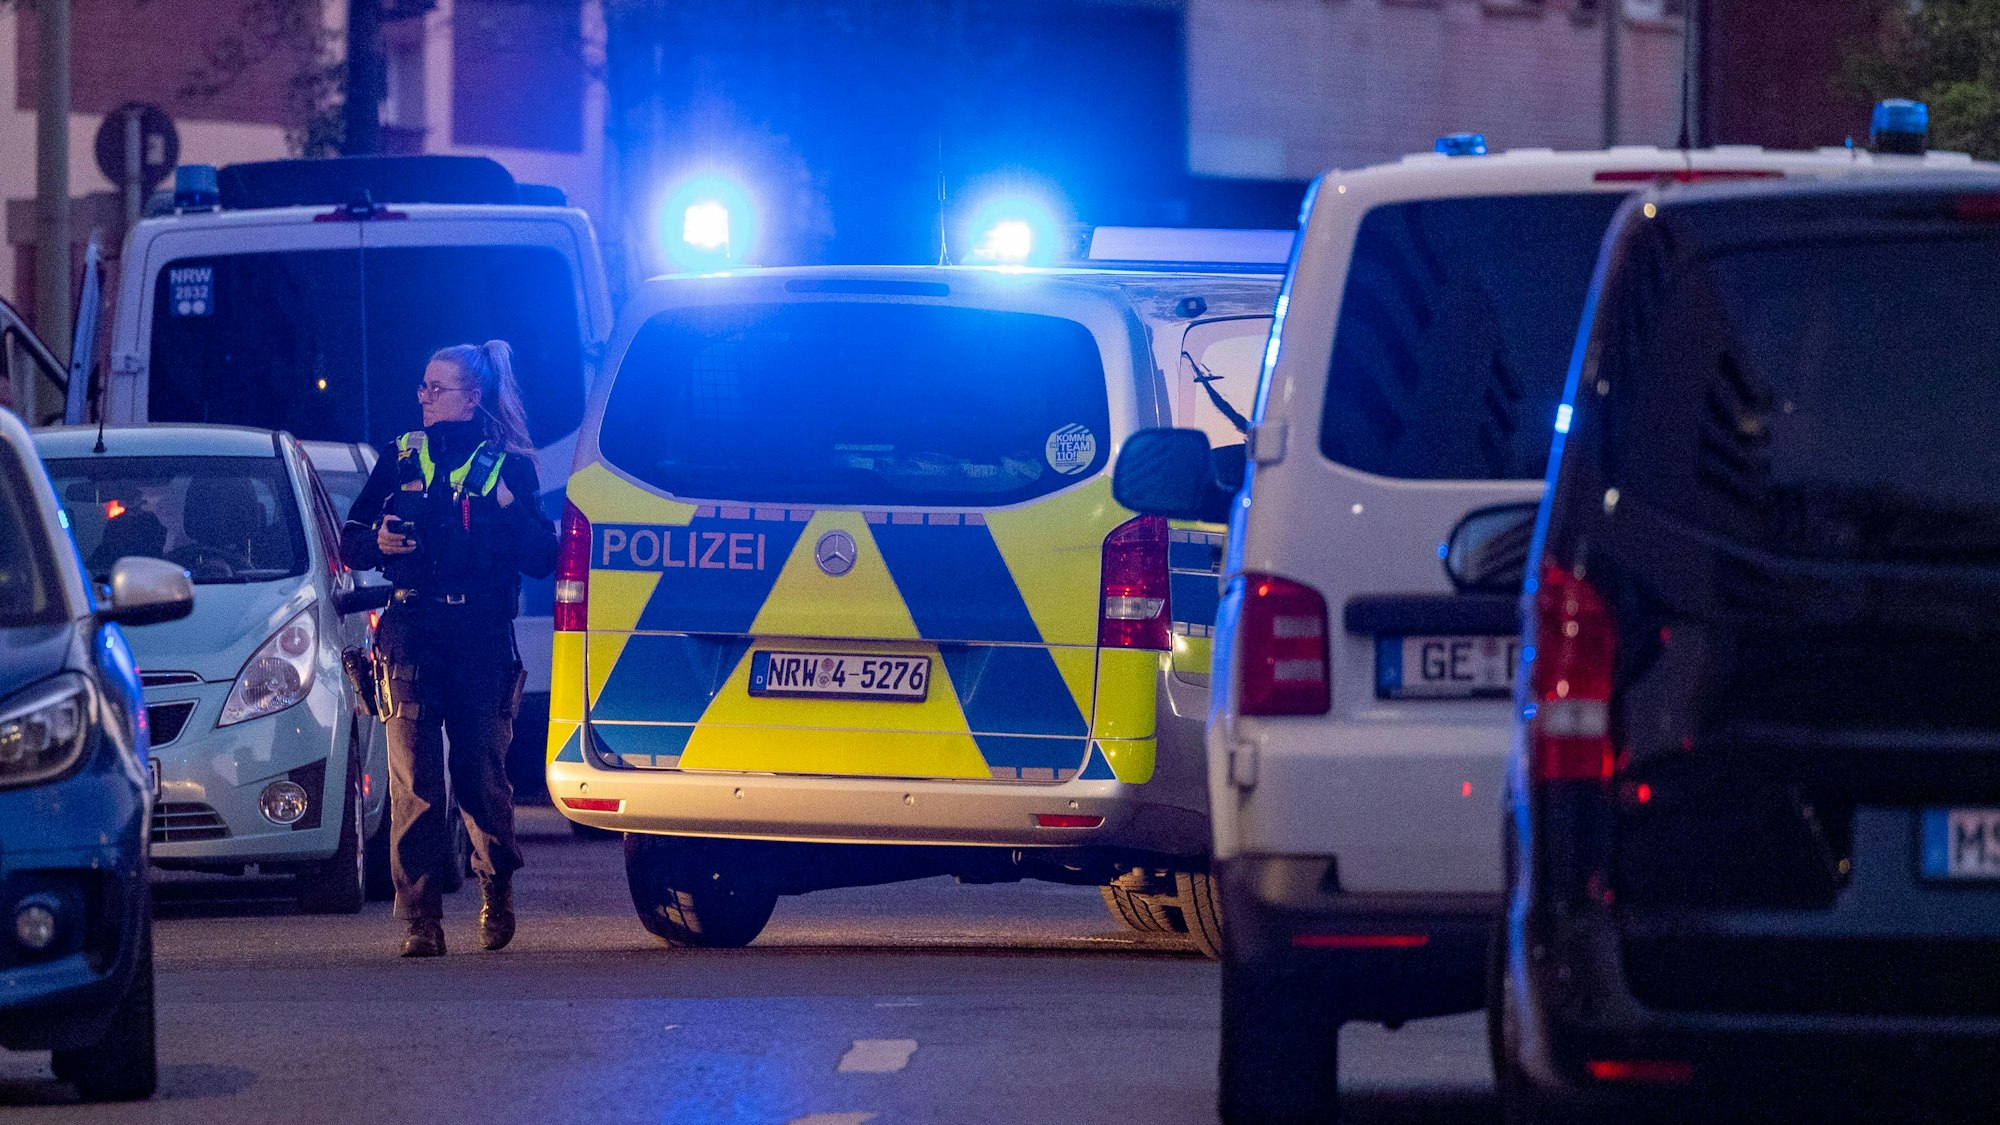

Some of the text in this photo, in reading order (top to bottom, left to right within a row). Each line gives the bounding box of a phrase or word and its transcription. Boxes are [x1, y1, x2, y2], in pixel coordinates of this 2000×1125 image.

[170, 268, 212, 284] NRW
[1056, 433, 1086, 442] KOMM
[1060, 441, 1091, 451] TEAM
[1056, 451, 1077, 461] 110!
[602, 529, 766, 571] POLIZEI
[1421, 641, 1474, 681] GE
[756, 658, 924, 690] D NRW 4-5276
